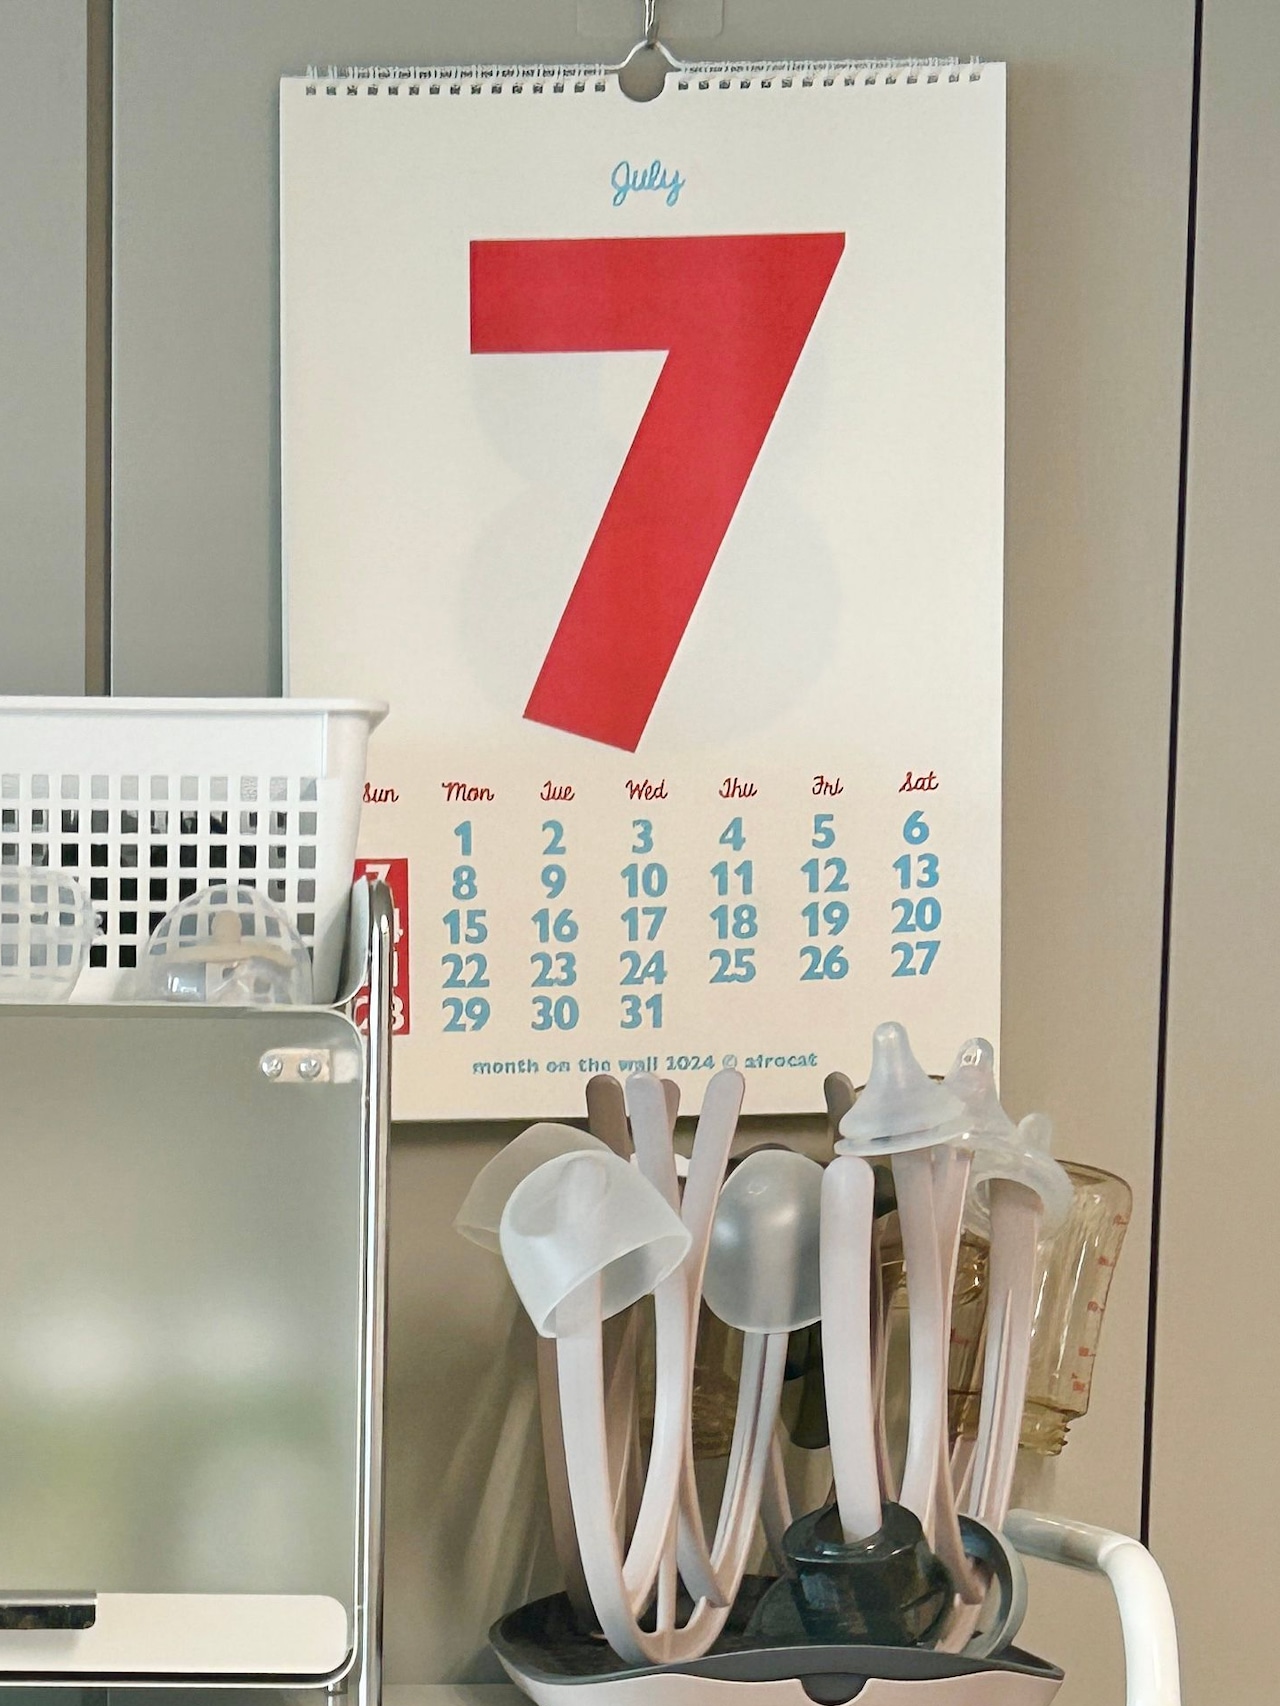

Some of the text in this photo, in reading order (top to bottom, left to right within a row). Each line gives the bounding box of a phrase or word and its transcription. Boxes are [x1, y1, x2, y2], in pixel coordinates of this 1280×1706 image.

[611, 160, 686, 206] July
[469, 231, 846, 753] 7
[362, 771, 939, 803] Sun Mon Tue Wed Thu Fri Sat
[454, 810, 930, 856] 1 2 3 4 5 6
[452, 865, 478, 900] 8
[541, 864, 567, 899] 9
[620, 863, 667, 898] 10
[710, 860, 753, 895] 11
[800, 857, 849, 893] 12
[892, 853, 939, 889] 13
[443, 909, 488, 944] 15
[531, 909, 578, 943] 16
[621, 907, 668, 941] 17
[709, 904, 758, 939] 18
[801, 901, 849, 937] 19
[891, 897, 941, 934] 20
[442, 941, 941, 988] 22 23 24 25 26 27
[442, 997, 490, 1032] 29
[531, 996, 579, 1030] 30
[620, 994, 663, 1029] 31
[472, 1058, 539, 1074] month
[546, 1060, 570, 1073] on
[578, 1058, 611, 1073] the
[618, 1056, 658, 1072] wall
[665, 1055, 716, 1071] 2024
